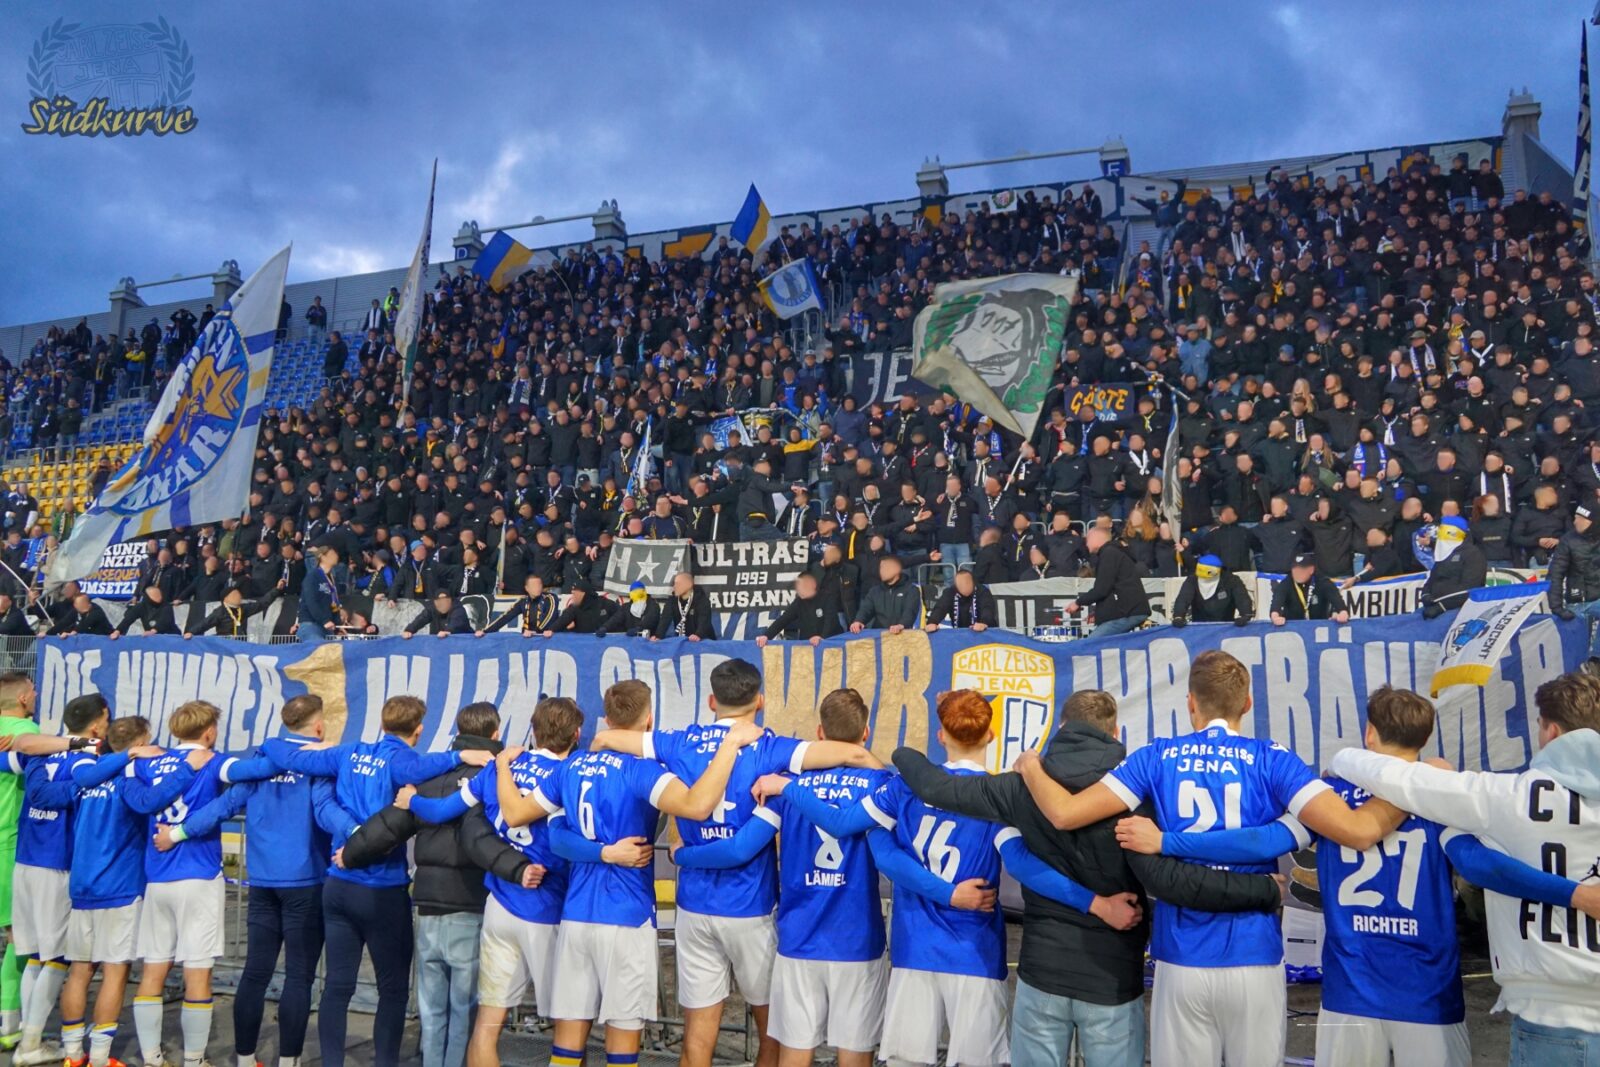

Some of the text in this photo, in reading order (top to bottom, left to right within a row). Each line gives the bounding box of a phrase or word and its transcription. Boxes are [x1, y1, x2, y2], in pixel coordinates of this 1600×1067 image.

[1108, 162, 1119, 175] F
[858, 352, 914, 412] JE
[1070, 385, 1129, 415] GÄSTE
[103, 542, 149, 556] KUNFT
[697, 540, 809, 567] ULTRAS
[736, 571, 768, 586] 1993
[709, 590, 797, 609] AUSANN
[958, 648, 1049, 672] CARL ZEISS
[975, 677, 1033, 693] JENA
[40, 644, 101, 737] DIE
[116, 650, 285, 751] NUMMER
[361, 653, 431, 743] IM
[427, 648, 578, 752] LAND
[762, 630, 933, 765] WIR
[1072, 637, 1191, 755] IHR
[1002, 697, 1048, 769] FC
[1162, 744, 1255, 766] FC CARL ZEISS
[1177, 758, 1239, 775] JENA
[798, 776, 811, 787] FC
[841, 775, 869, 789] ZEISS
[578, 780, 596, 840] 6
[1177, 780, 1242, 833] 21
[912, 814, 960, 884] 16
[1338, 828, 1427, 911] 27
[1353, 914, 1418, 936] RICHTER
